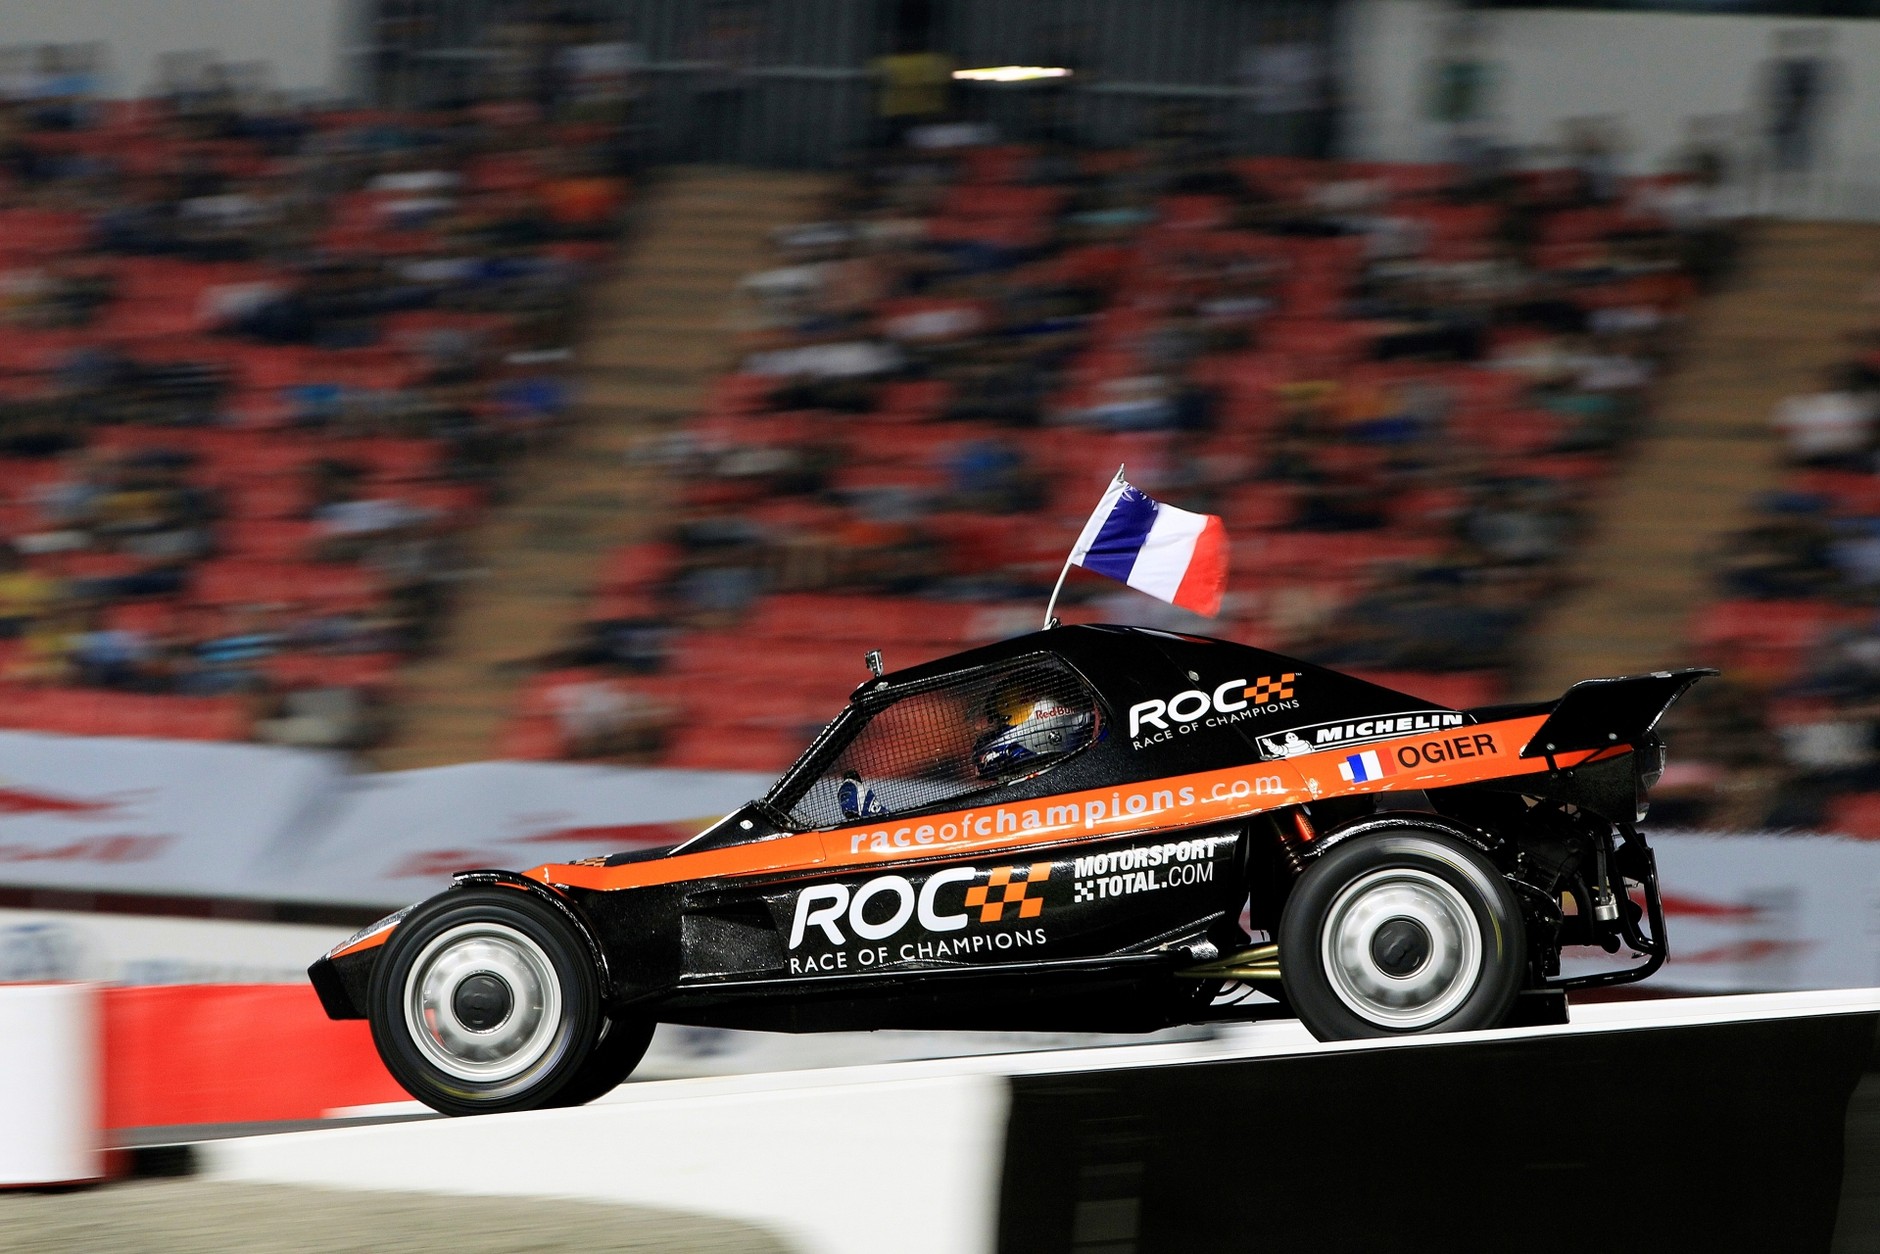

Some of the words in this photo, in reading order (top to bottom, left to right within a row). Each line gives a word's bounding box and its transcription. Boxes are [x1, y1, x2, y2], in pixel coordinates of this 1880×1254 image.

[1129, 679, 1247, 738] ROC
[1133, 729, 1173, 750] RACE
[1178, 721, 1199, 734] OF
[1205, 699, 1300, 728] CHAMPIONS
[1316, 714, 1463, 743] MICHELIN
[1398, 734, 1497, 768] OGIER
[849, 773, 1284, 855] raceofchampions.com
[1074, 837, 1216, 878] MOTORSPORT
[1097, 862, 1213, 898] TOTAL.COM
[788, 866, 977, 950] ROC
[790, 952, 848, 975] RACE
[858, 946, 889, 966] OF
[900, 928, 1047, 960] CHAMPIONS
